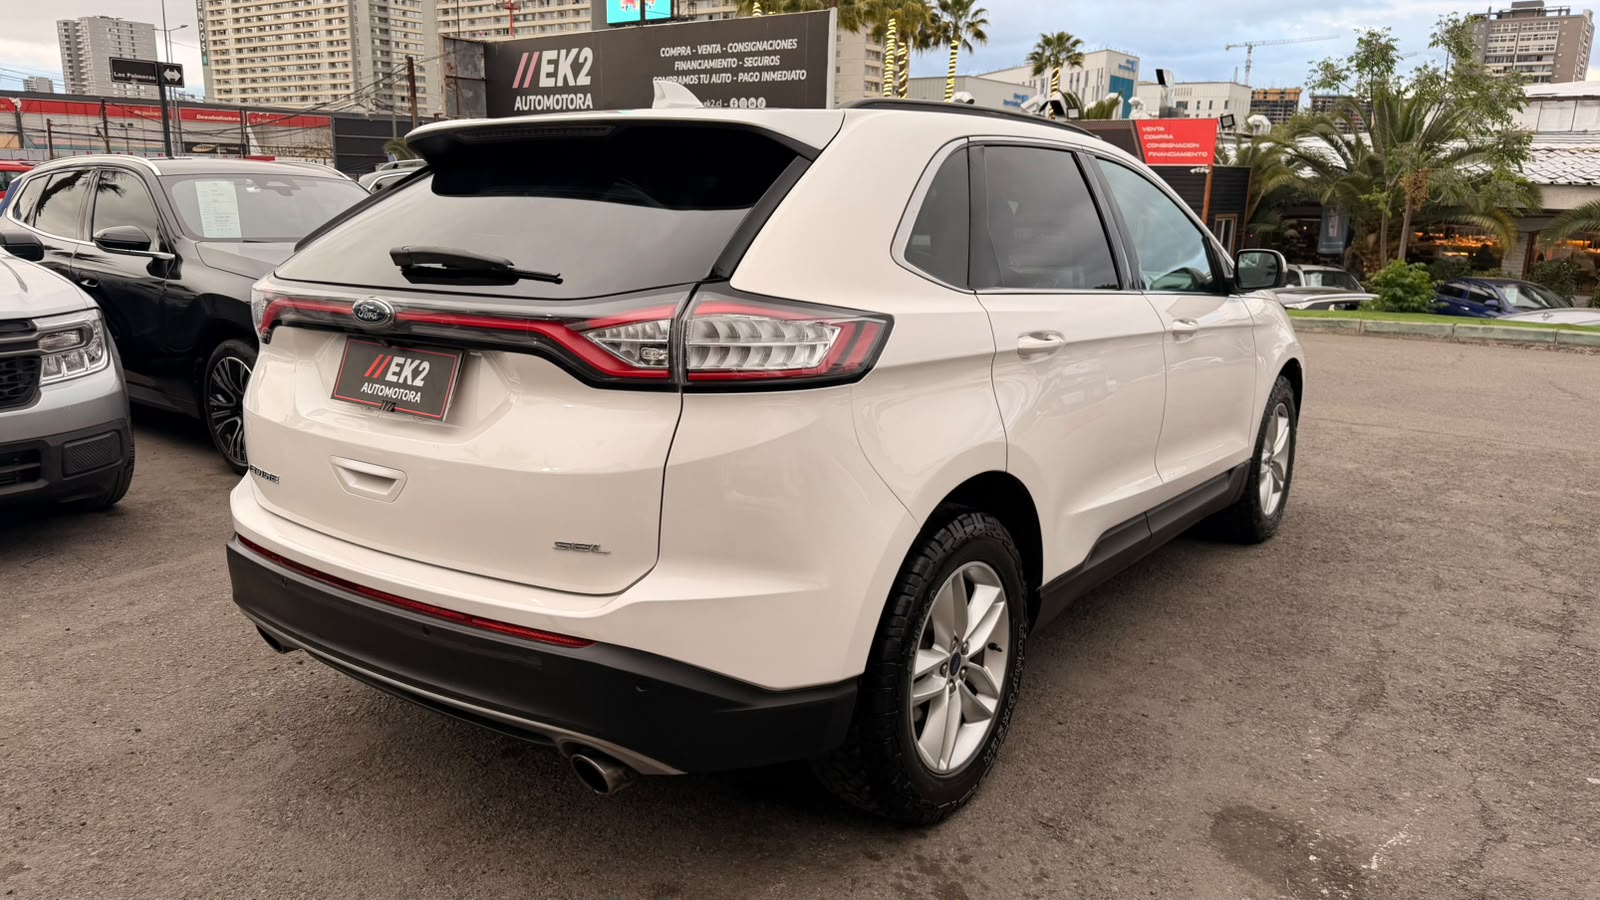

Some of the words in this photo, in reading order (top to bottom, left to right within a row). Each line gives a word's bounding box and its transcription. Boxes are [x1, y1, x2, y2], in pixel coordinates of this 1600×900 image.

[660, 46, 691, 57] COMPRA
[697, 44, 721, 55] VENTA
[727, 38, 798, 53] CONSIGNACIONES
[674, 58, 737, 71] FINANCIAMIENTO
[743, 55, 780, 67] SEGUROS
[700, 74, 709, 84] TU
[710, 73, 732, 84] AUTO
[738, 72, 760, 83] PAGO
[761, 70, 807, 81] INMEDIATO
[514, 93, 593, 111] AUTOMOTORA
[358, 304, 379, 320] Ford
[360, 382, 421, 403] AUTOMOTORA
[552, 541, 611, 555] SEL
